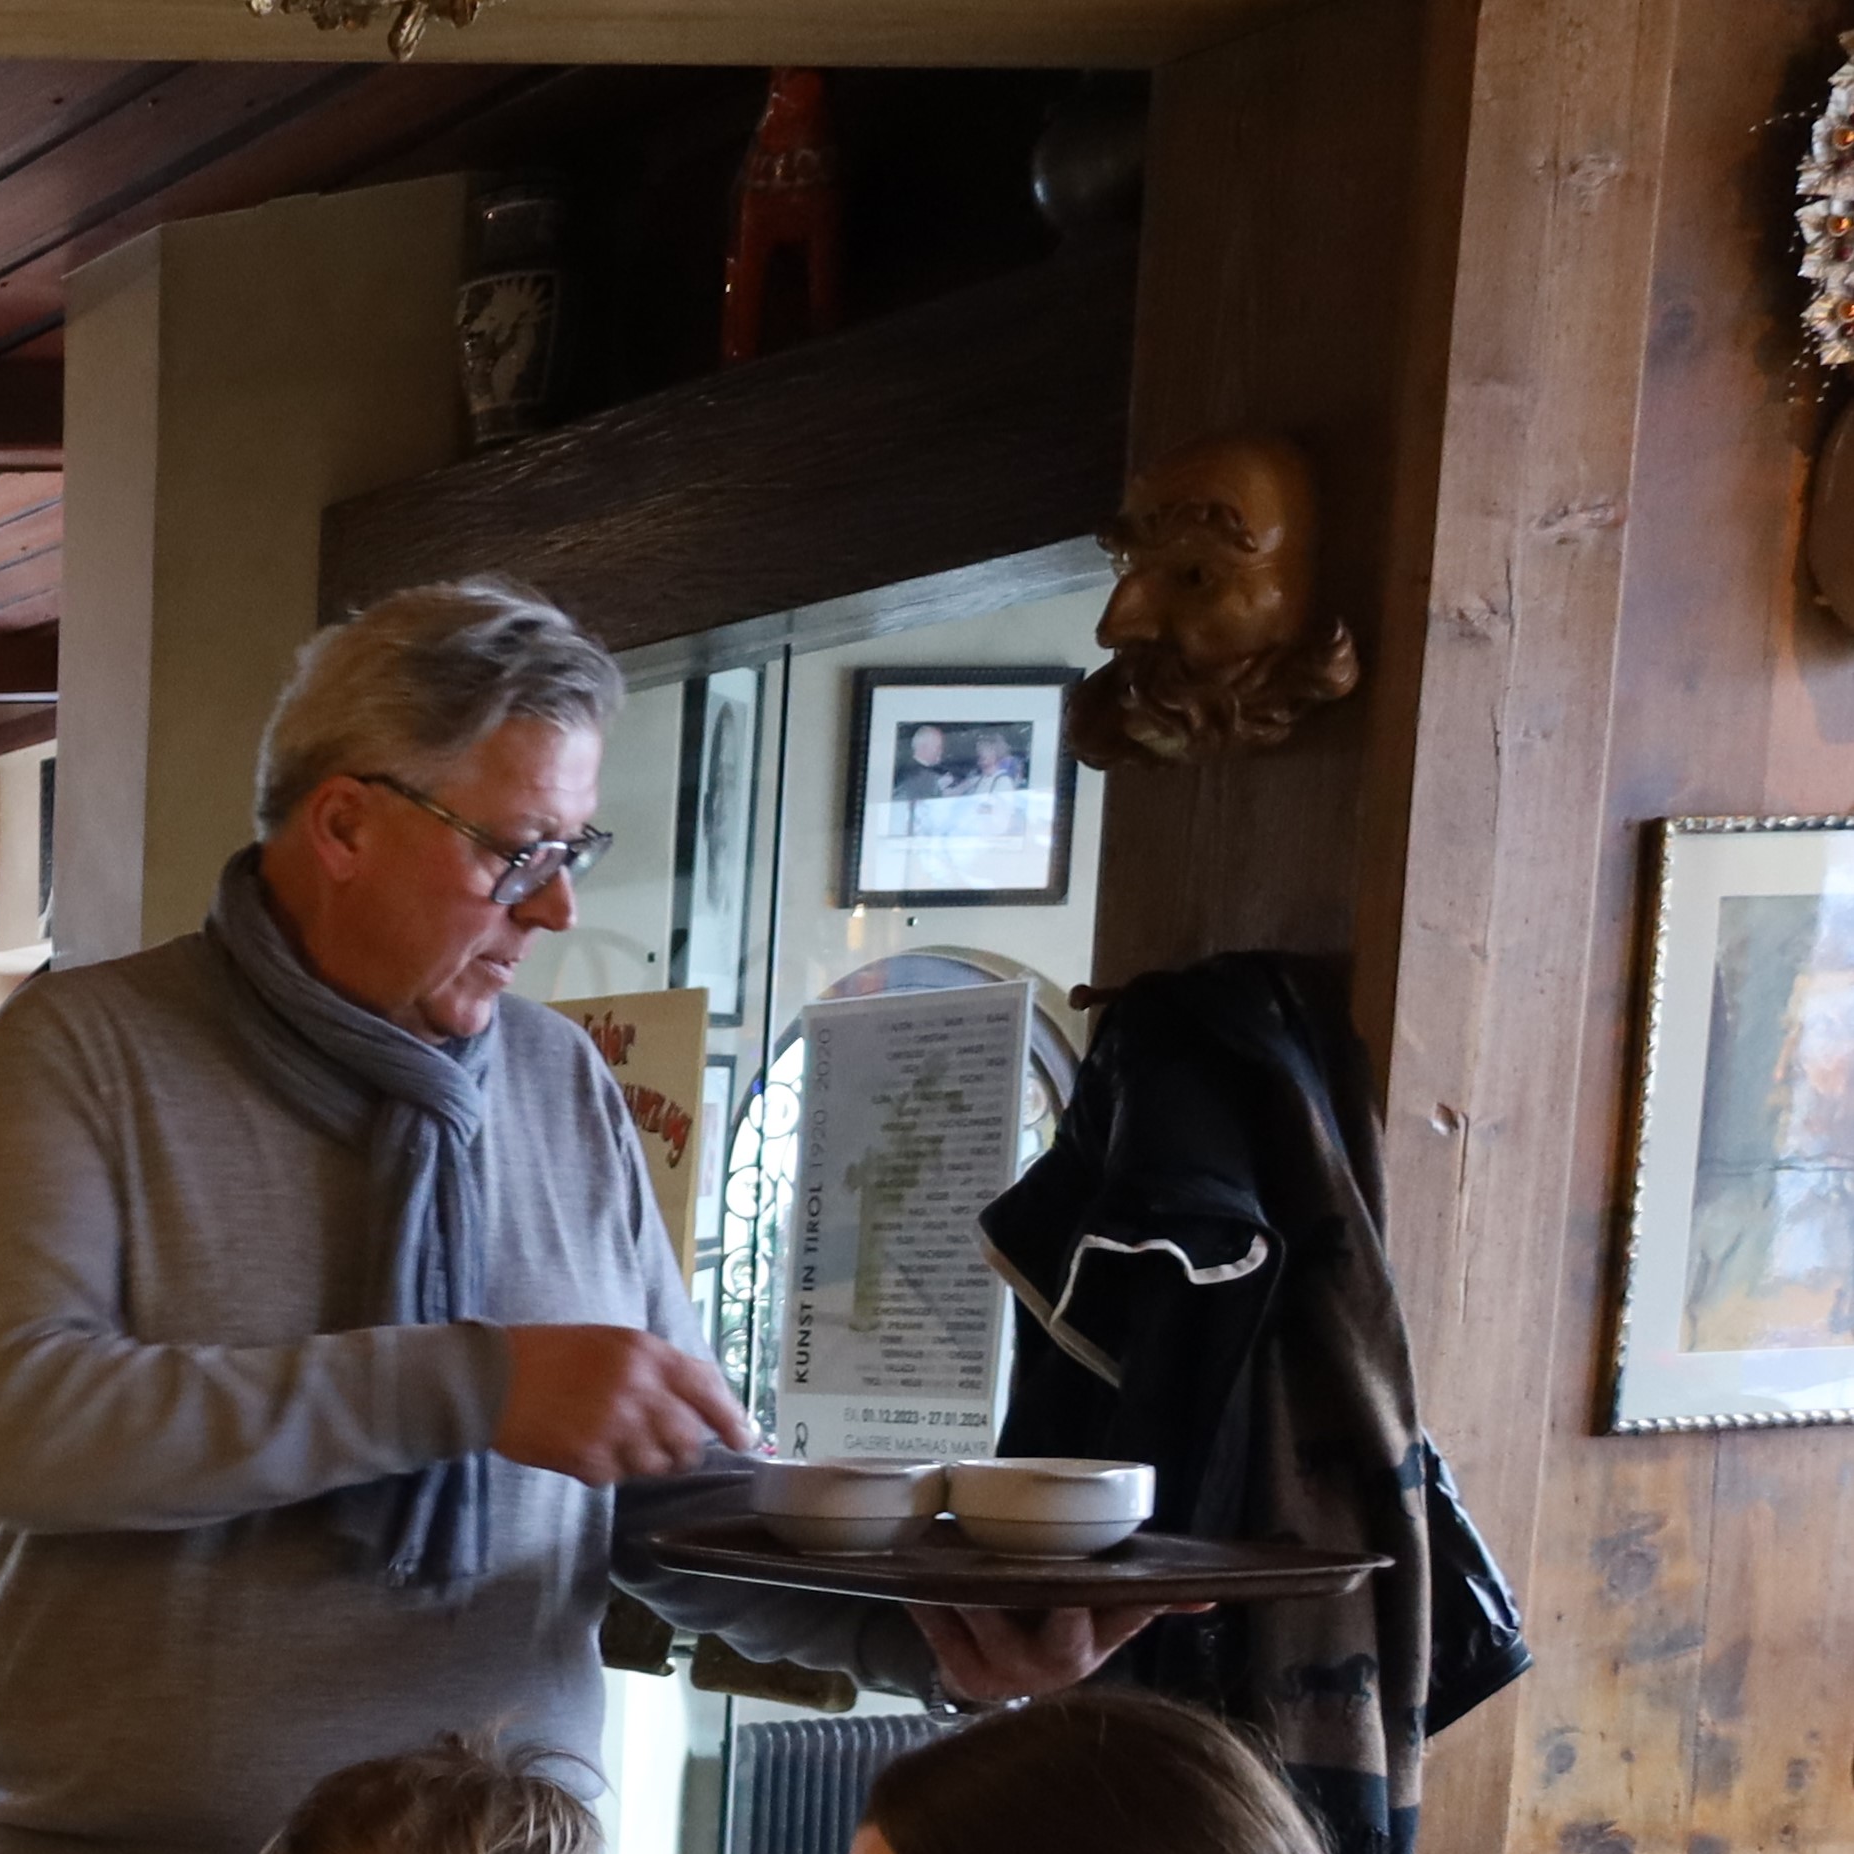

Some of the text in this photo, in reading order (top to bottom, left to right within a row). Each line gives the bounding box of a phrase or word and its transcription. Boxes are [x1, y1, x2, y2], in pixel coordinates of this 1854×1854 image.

[802, 1181, 823, 1255] TIROL
[801, 1265, 816, 1292] IN
[794, 1303, 813, 1384] KUNST
[843, 1433, 892, 1451] GALERIE
[894, 1435, 948, 1454] MATHIAS
